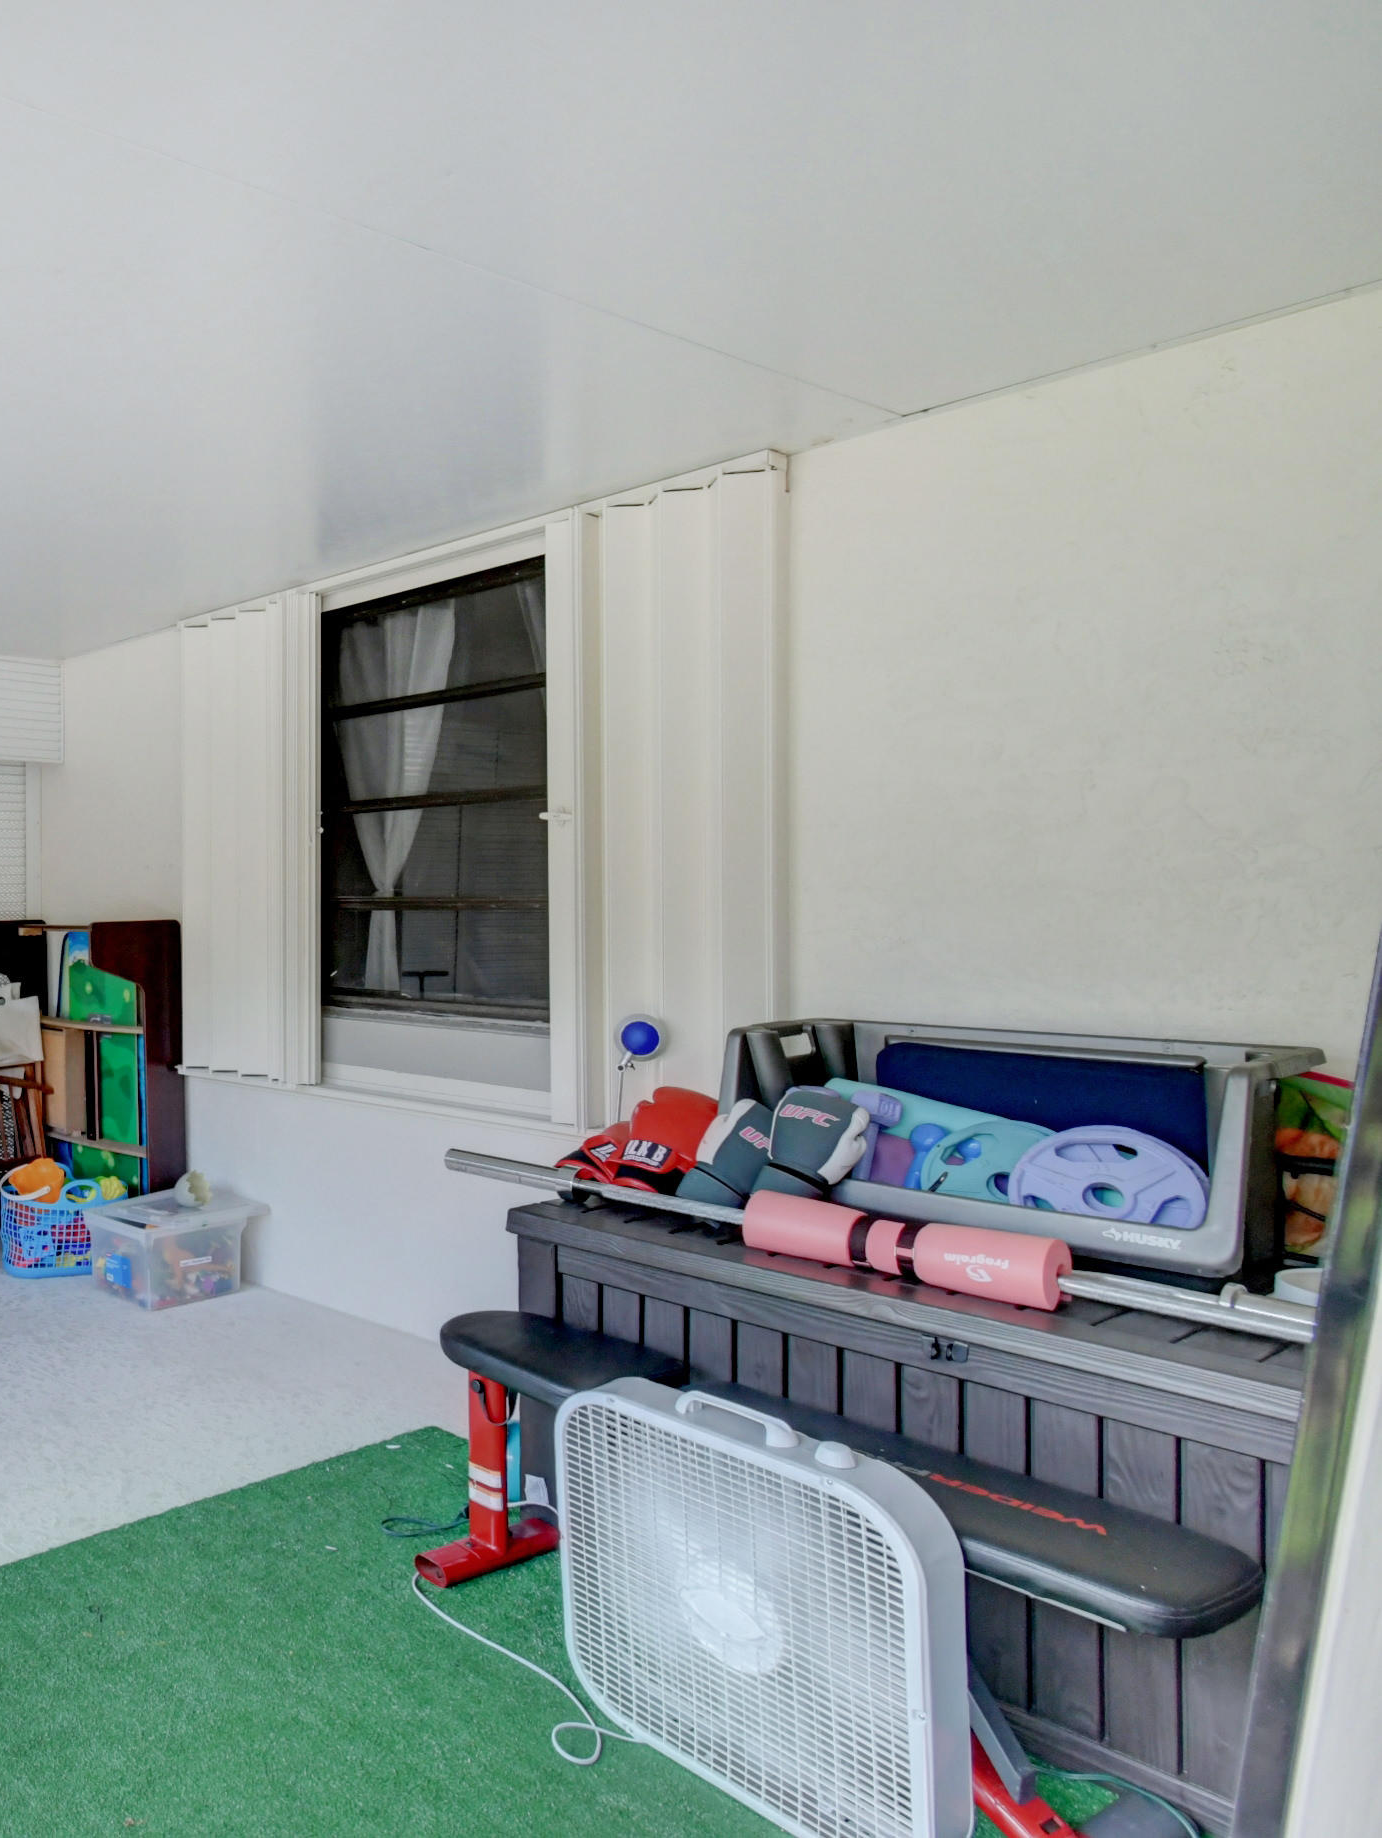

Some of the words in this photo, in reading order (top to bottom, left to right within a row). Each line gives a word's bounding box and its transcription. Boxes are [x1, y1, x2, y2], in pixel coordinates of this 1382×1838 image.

[779, 1103, 841, 1128] UFC
[739, 1126, 771, 1150] UF
[1122, 1231, 1182, 1250] HUSKY
